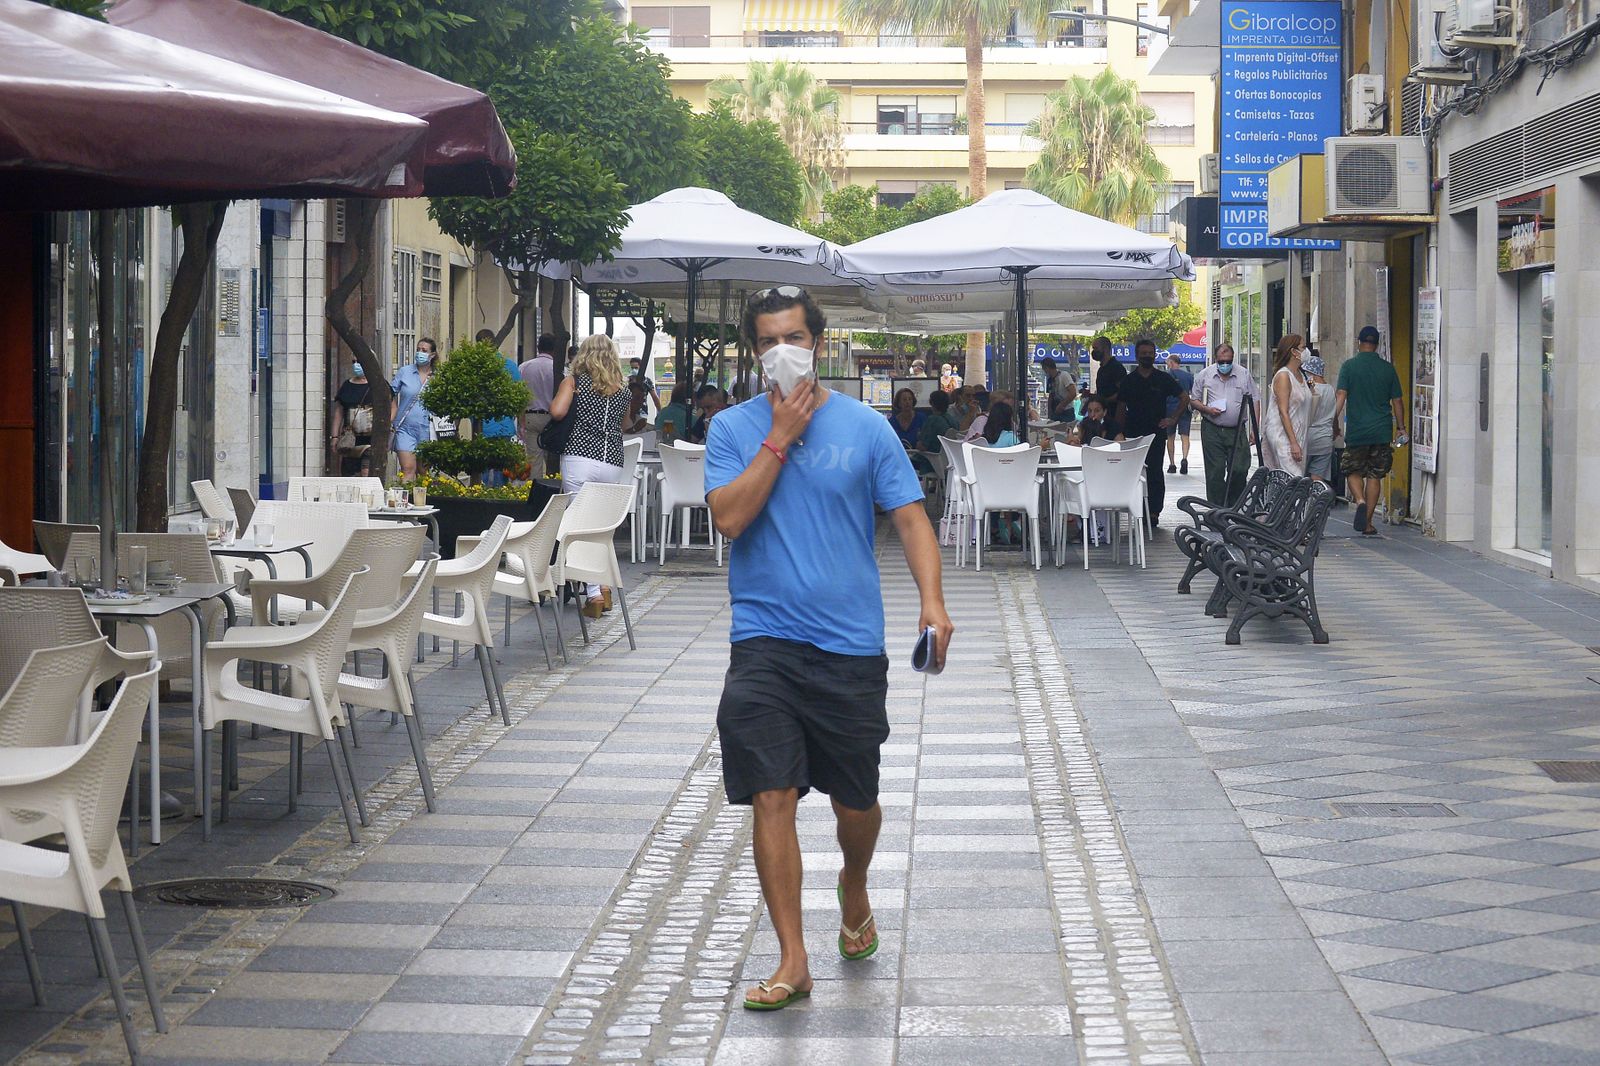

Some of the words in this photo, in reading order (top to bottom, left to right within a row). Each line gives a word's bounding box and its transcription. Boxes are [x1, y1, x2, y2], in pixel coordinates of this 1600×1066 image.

[1229, 9, 1337, 34] Gibralcop
[1228, 35, 1286, 44] IMPRENTA
[1291, 35, 1336, 44] DIGITAL
[1234, 52, 1275, 64] Imprenta
[1277, 52, 1338, 65] Digital-Offset
[1234, 70, 1270, 81] Regalos
[1272, 69, 1328, 80] Publicitarios
[1234, 89, 1268, 100] Ofertas
[1270, 89, 1322, 102] Bonocopias
[1234, 109, 1281, 120] Camisetas
[1289, 110, 1315, 120] Tazas
[1234, 130, 1279, 141] Cartelería
[1288, 131, 1318, 141] Planos
[1234, 153, 1261, 164] Sellos
[1263, 153, 1274, 164] de
[1231, 190, 1268, 200] www.g
[1224, 210, 1268, 224] IMPR
[1203, 226, 1219, 234] AL
